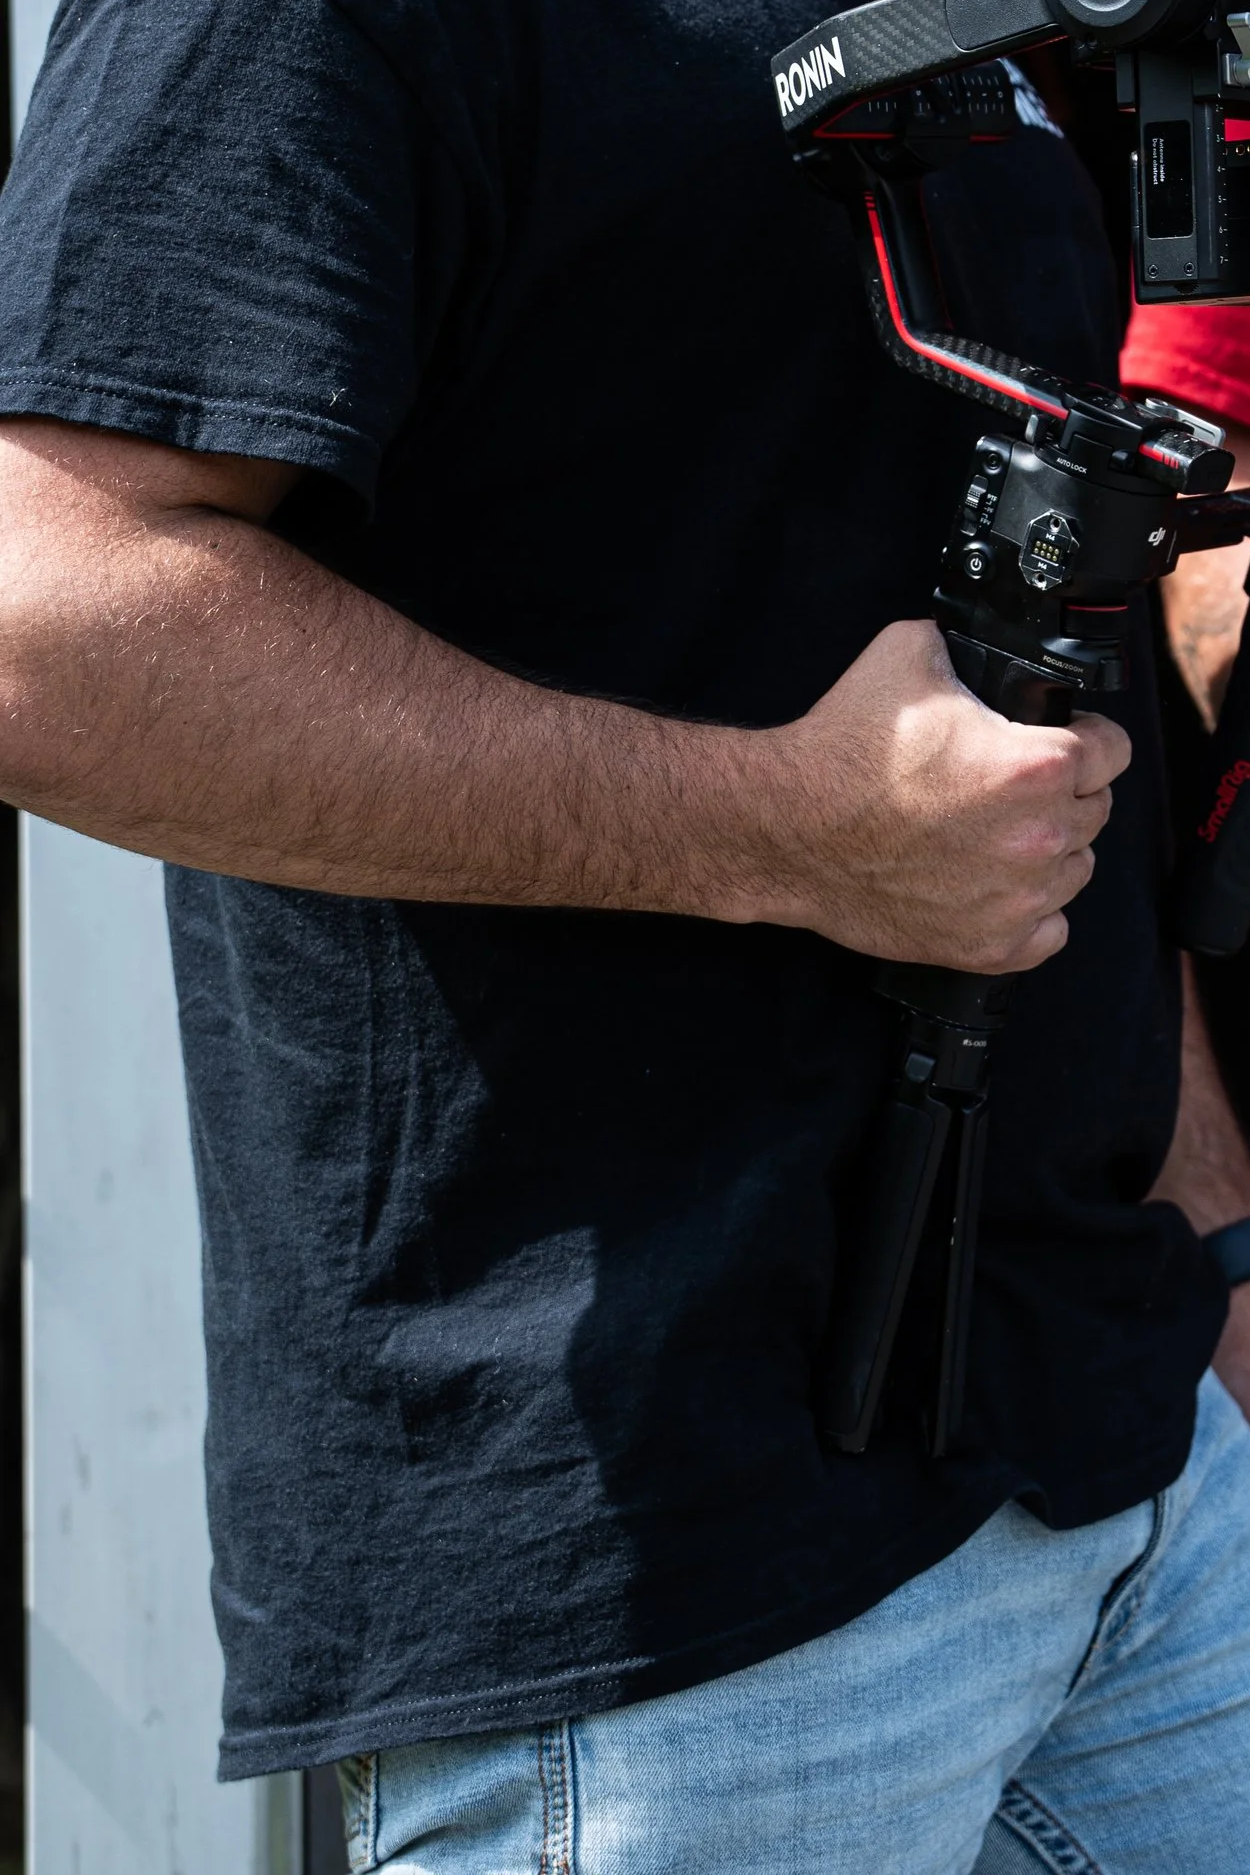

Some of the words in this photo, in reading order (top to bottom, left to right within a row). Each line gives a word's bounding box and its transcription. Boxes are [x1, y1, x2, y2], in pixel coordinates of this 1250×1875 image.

[774, 36, 846, 117] RONIN
[1152, 138, 1158, 148] Do
[1056, 457, 1071, 468] AUTO
[1071, 463, 1088, 474] LOCK
[1042, 654, 1084, 674] FOCUS/ZOOM
